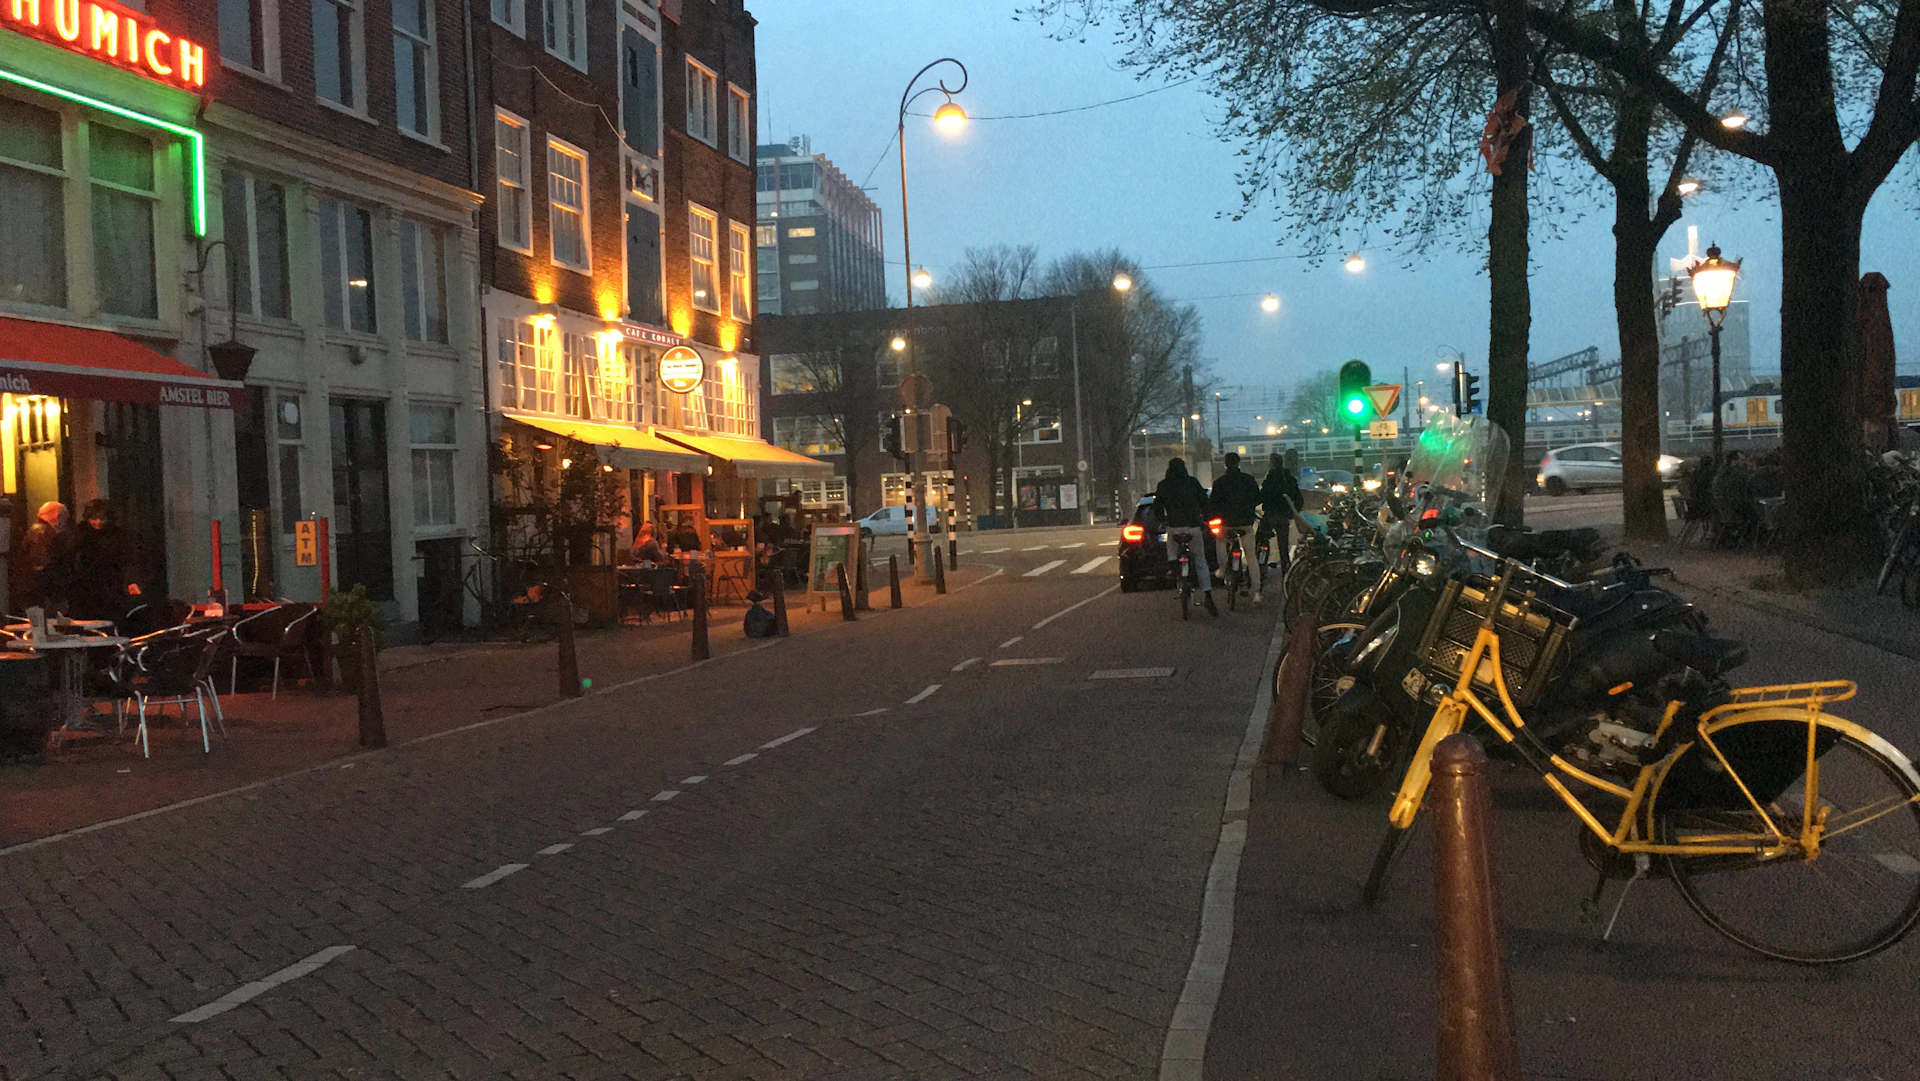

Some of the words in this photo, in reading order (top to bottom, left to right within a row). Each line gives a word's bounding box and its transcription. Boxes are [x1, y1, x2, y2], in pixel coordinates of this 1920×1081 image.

[651, 333, 680, 346] KOBALT
[160, 385, 204, 404] AMSTEL
[206, 389, 231, 406] BIER
[300, 523, 313, 564] ATM
